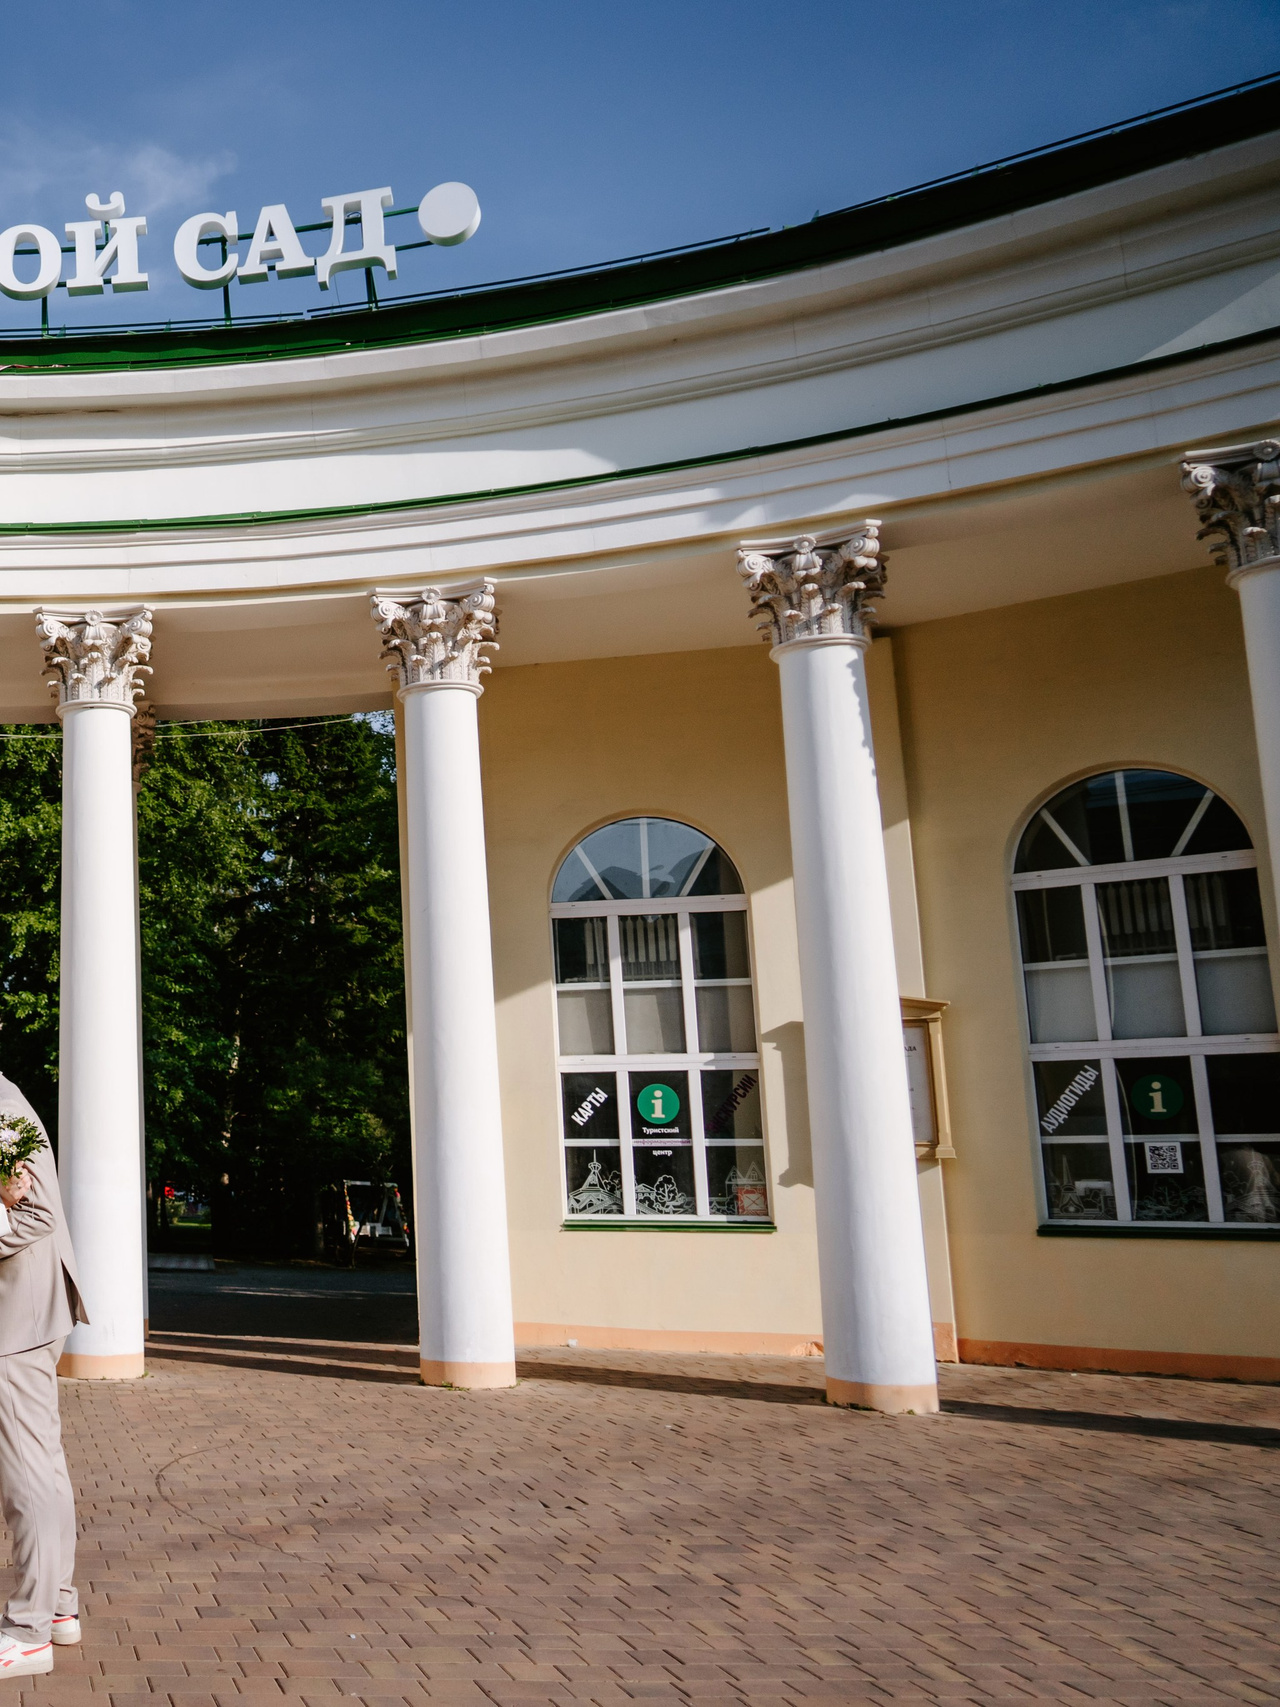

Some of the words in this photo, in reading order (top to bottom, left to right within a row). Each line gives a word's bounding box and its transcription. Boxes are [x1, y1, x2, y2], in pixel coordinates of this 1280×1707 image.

[173, 186, 398, 292] САД
[570, 1087, 609, 1127] КАРТЫ
[1040, 1064, 1100, 1134] АУДИОГИДЫ
[642, 1127, 680, 1135] Туристский
[652, 1149, 673, 1157] центр
